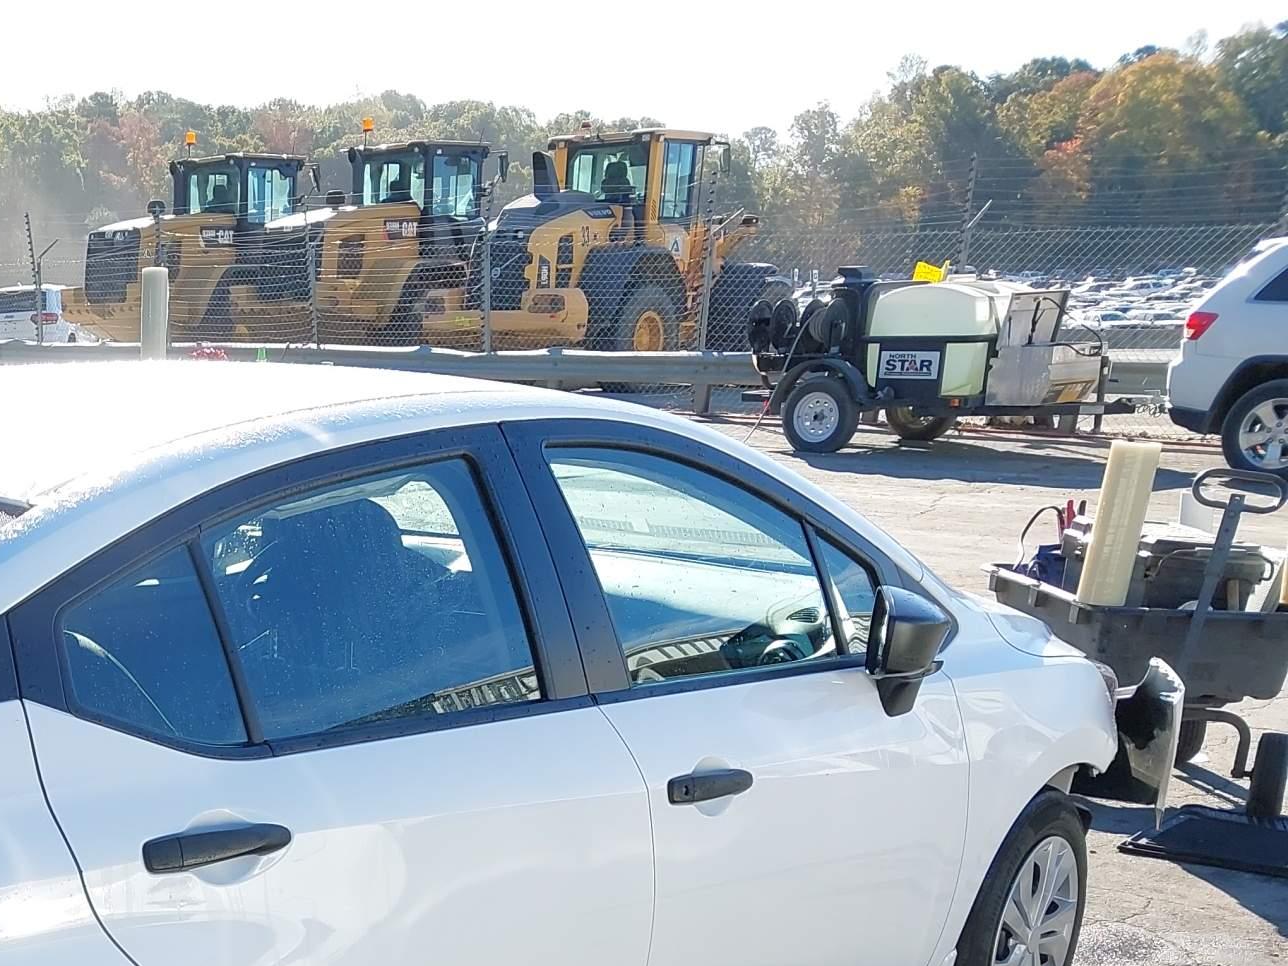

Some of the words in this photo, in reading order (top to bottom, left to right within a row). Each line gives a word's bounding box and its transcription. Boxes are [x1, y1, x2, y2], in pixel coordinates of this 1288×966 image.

[218, 229, 234, 244] CAT
[402, 221, 418, 237] CAT
[884, 359, 933, 372] STAR
